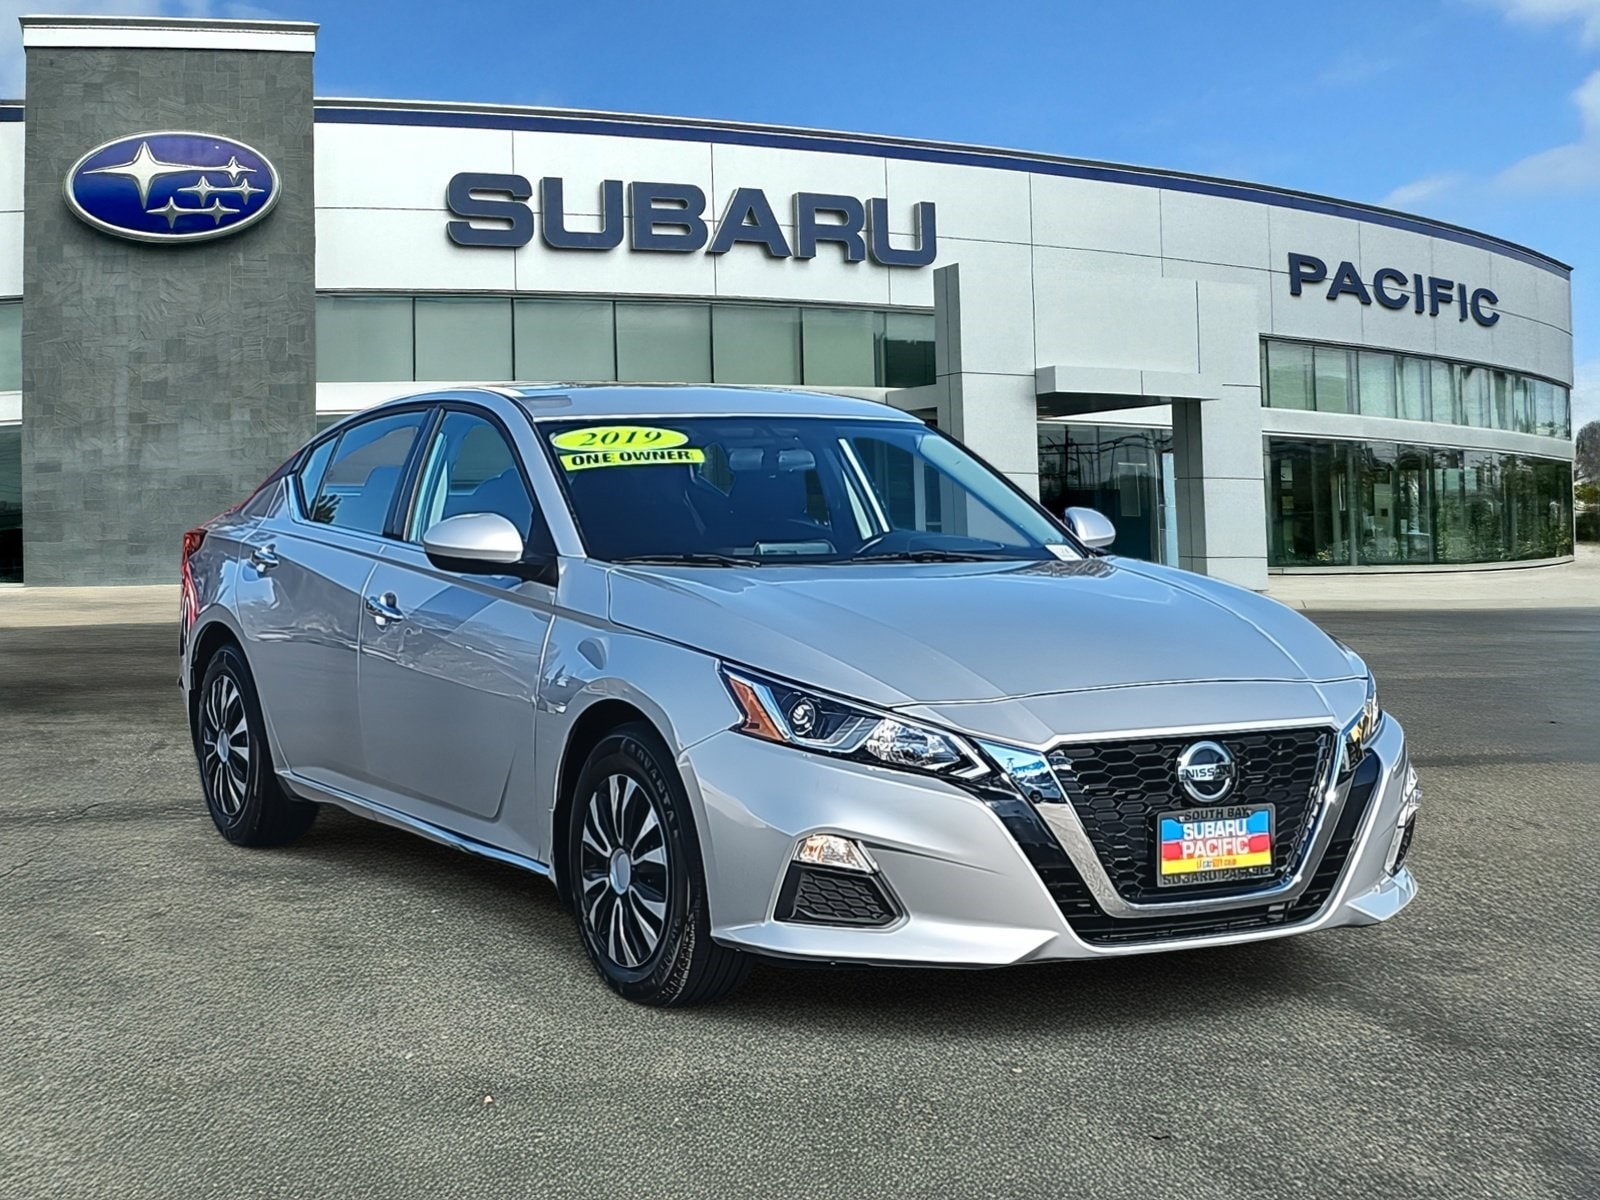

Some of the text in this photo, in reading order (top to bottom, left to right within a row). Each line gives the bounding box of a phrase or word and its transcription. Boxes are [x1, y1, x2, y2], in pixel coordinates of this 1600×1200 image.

[446, 171, 937, 268] SUBARU
[1288, 252, 1501, 328] PACIFIC
[578, 430, 662, 447] 2019
[571, 450, 692, 466] ONE OWNER
[1185, 766, 1232, 779] NISSAN
[1184, 807, 1250, 820] SOUTH BAY
[1182, 819, 1248, 840] SUBARU
[1181, 837, 1250, 859] PACIFIC
